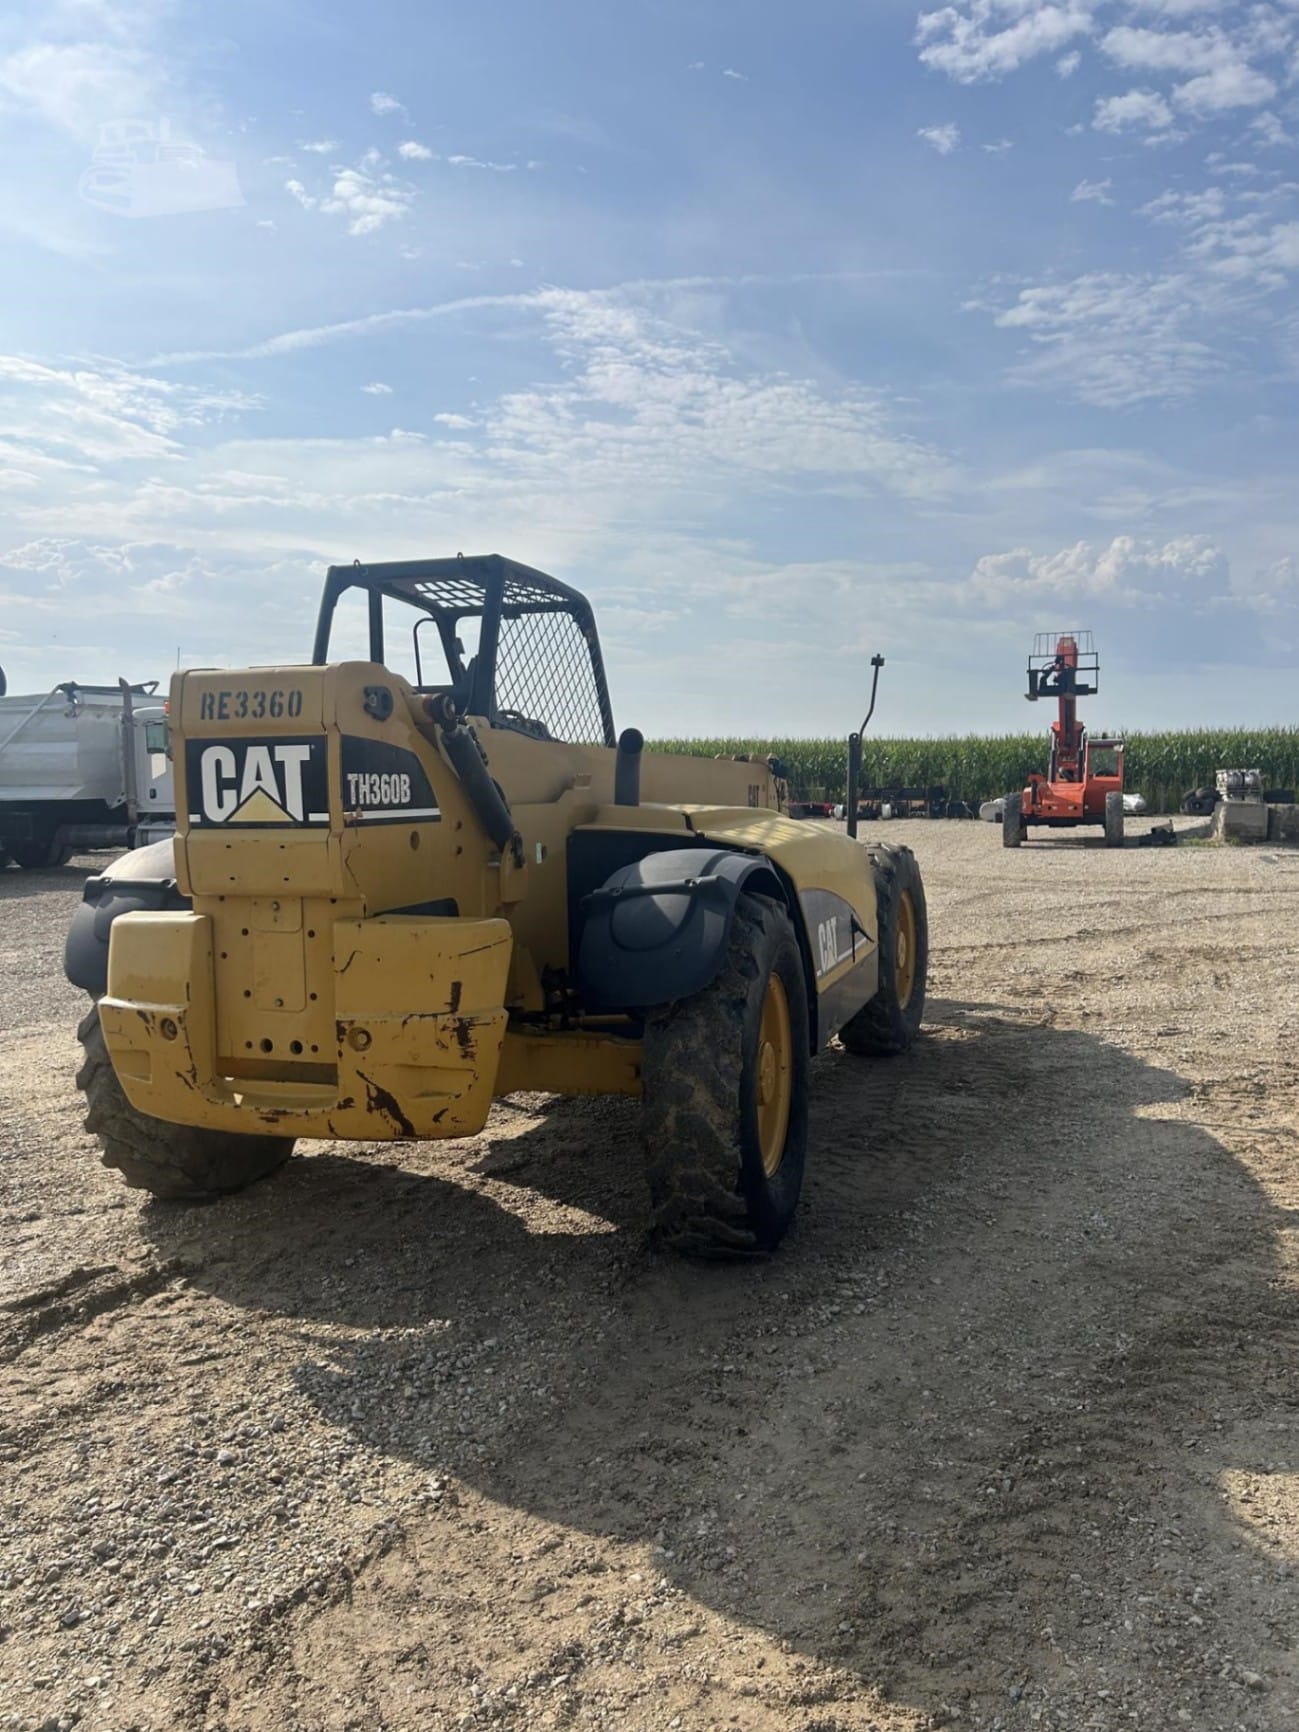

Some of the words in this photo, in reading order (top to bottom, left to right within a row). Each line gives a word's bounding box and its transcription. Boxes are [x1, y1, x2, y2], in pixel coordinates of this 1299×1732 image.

[200, 690, 303, 720] RE3360
[201, 744, 311, 822] CAT
[347, 773, 411, 805] TH360B
[818, 916, 838, 974] CAT
